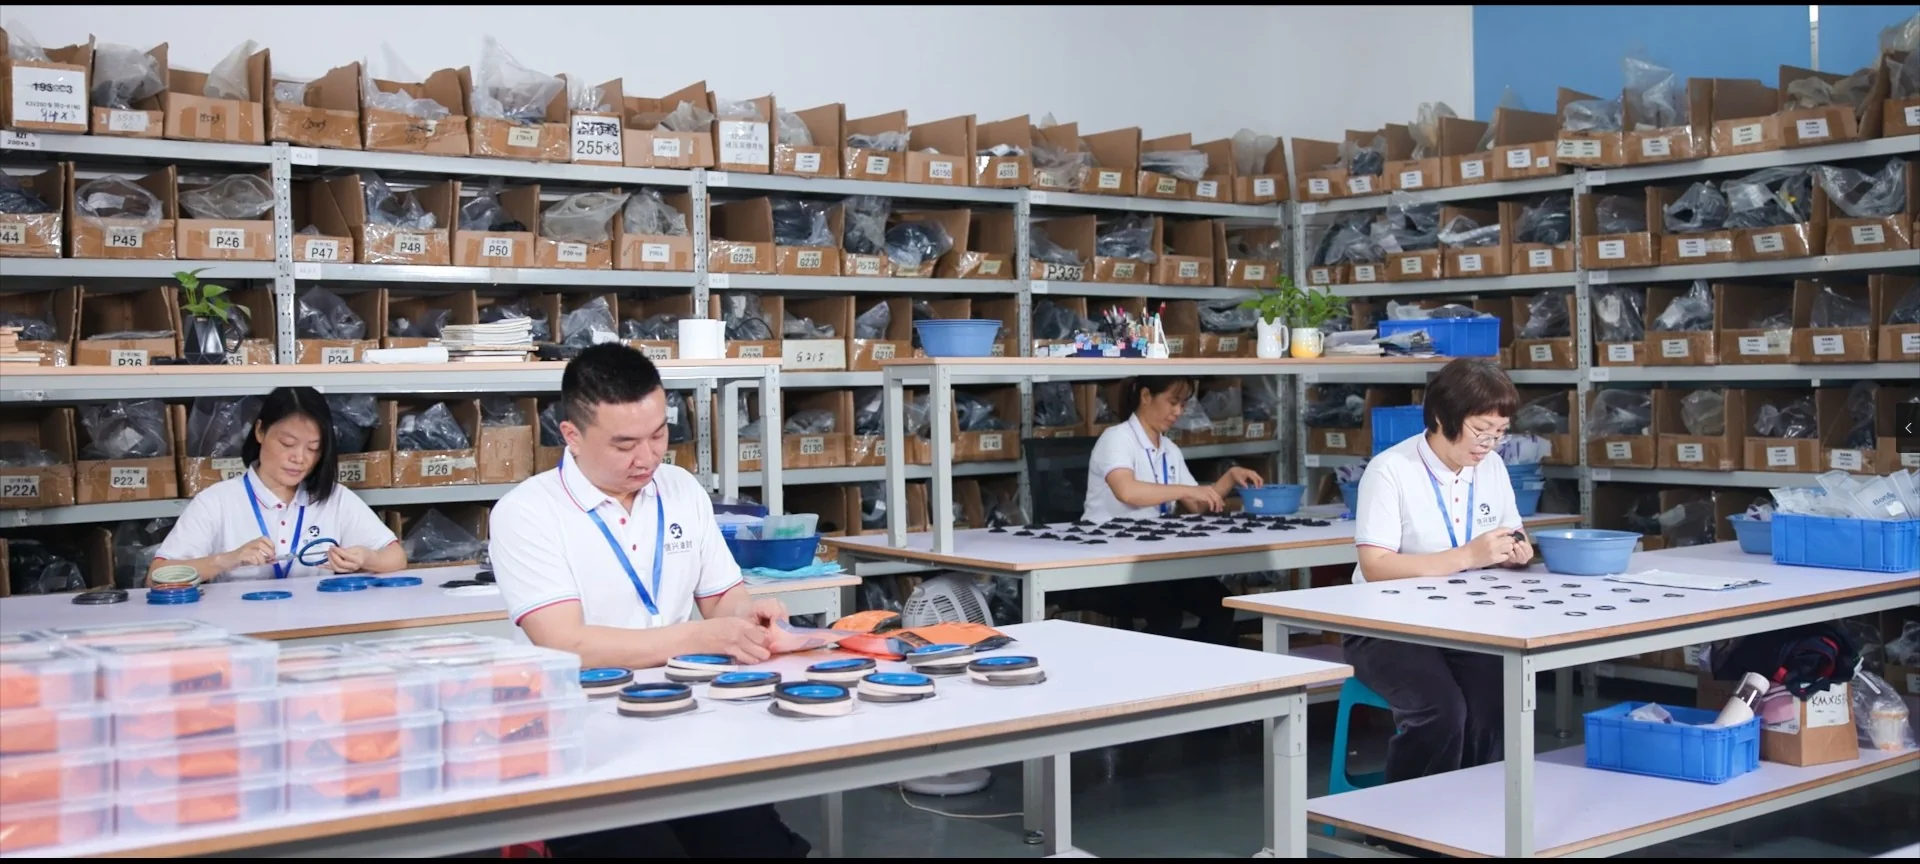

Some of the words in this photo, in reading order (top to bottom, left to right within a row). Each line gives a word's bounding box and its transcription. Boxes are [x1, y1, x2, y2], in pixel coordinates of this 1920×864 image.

[0, 231, 19, 244] 44
[112, 235, 137, 247] P45
[216, 236, 240, 248] P46
[311, 247, 333, 259] P47
[400, 242, 421, 254] P48
[488, 245, 508, 257] P50
[733, 253, 754, 263] G225
[800, 257, 820, 267] G230
[228, 355, 243, 366] 35
[803, 443, 822, 453] G130
[742, 449, 762, 461] G125
[427, 464, 448, 475] P26
[339, 470, 361, 482] P25
[4, 484, 38, 496] P22A
